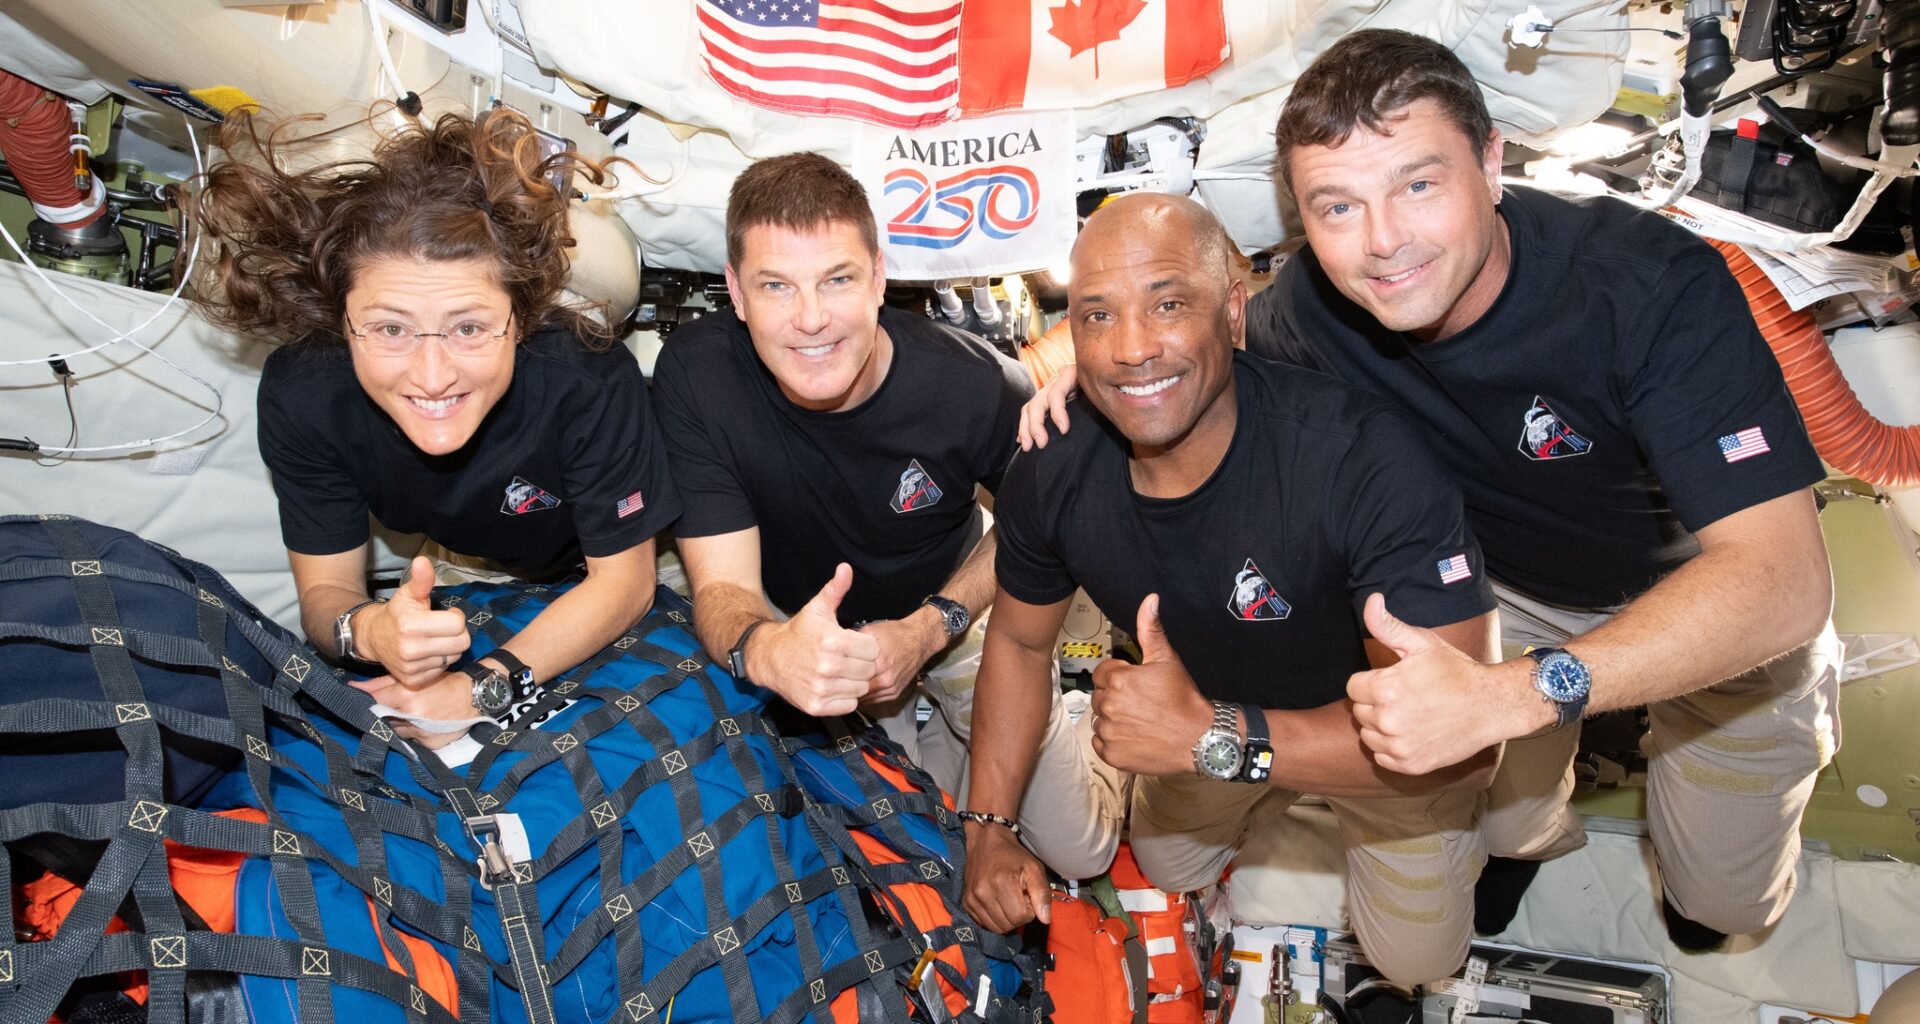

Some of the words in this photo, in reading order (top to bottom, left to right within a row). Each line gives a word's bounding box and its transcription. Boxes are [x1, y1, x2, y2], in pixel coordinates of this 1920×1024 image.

[886, 128, 1042, 167] AMERICA
[884, 165, 1040, 250] 250
[1682, 218, 1705, 231] NOT
